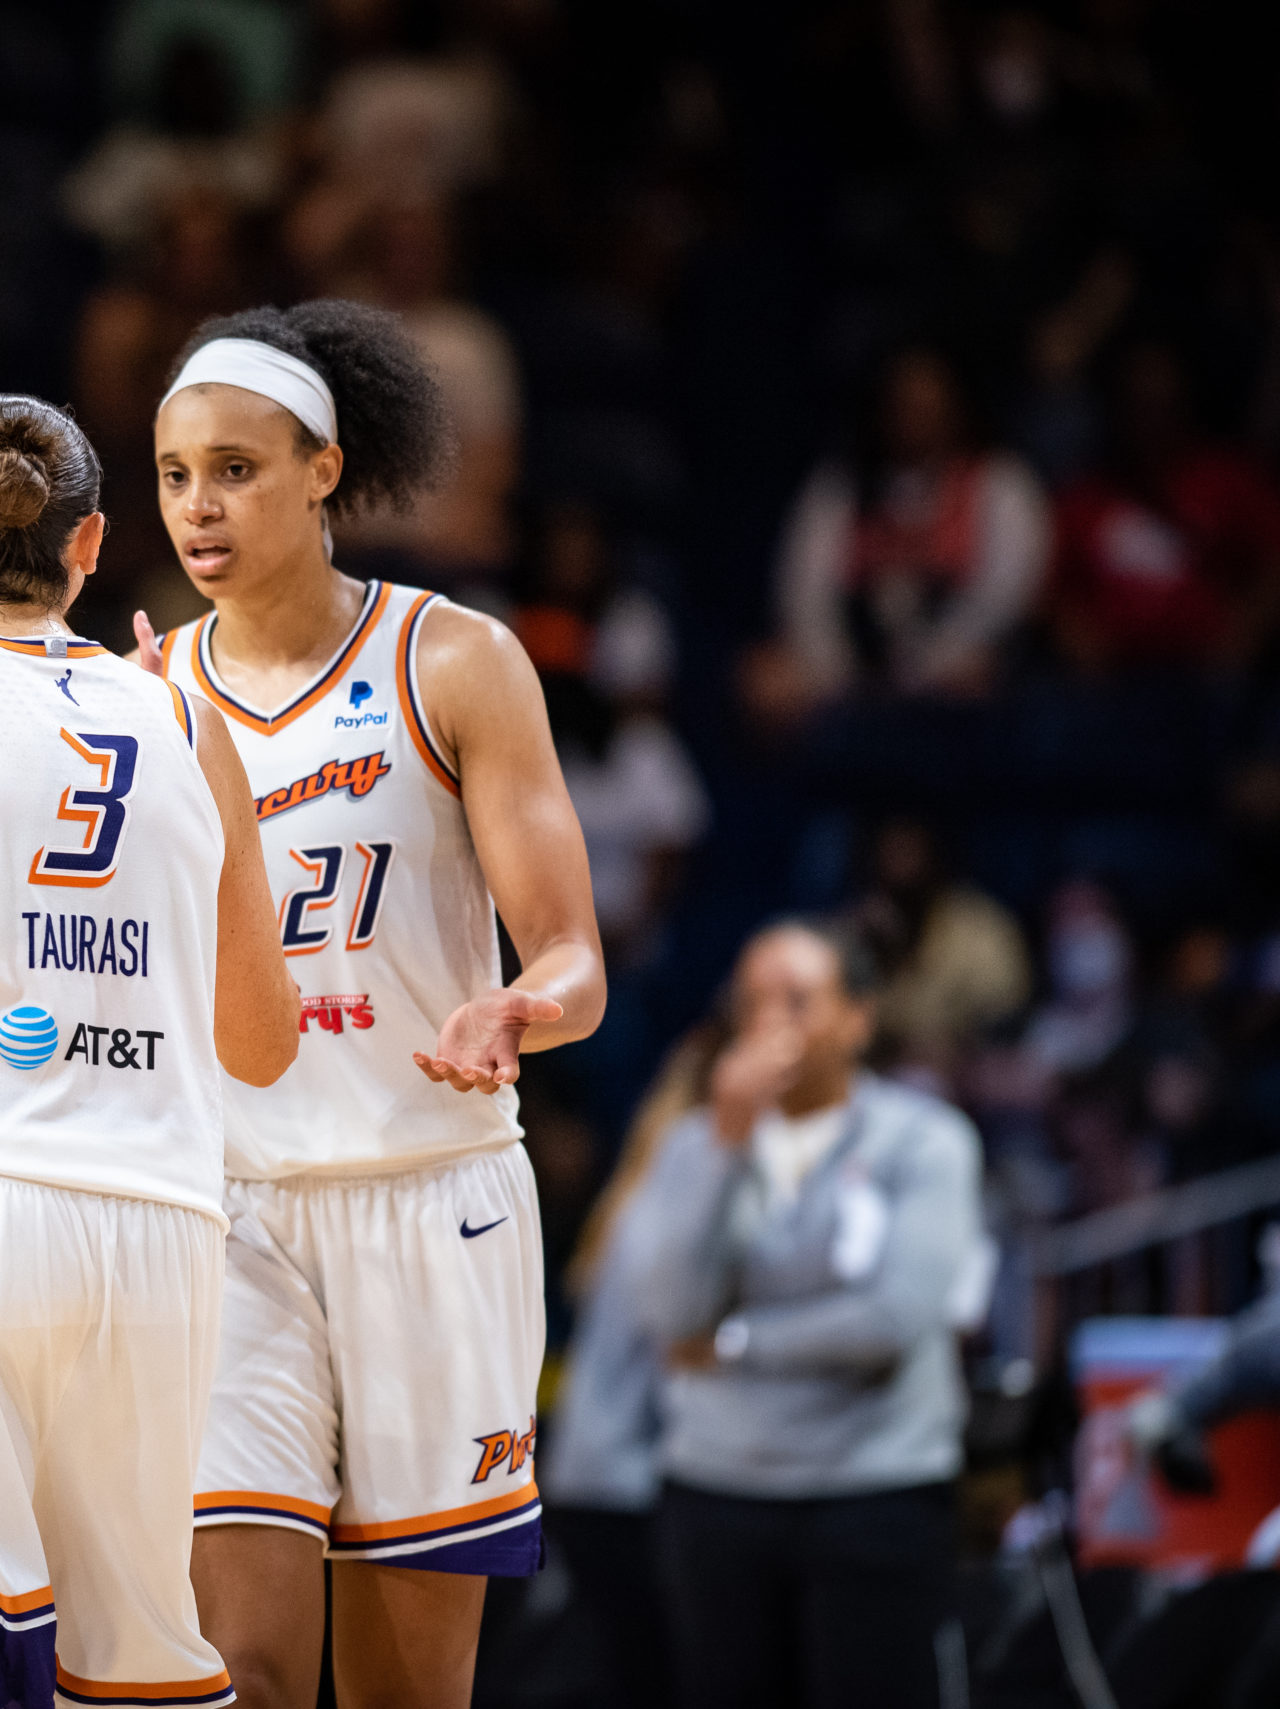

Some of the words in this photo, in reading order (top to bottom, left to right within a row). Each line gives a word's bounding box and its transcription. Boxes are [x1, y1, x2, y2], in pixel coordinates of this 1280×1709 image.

[334, 711, 388, 729] PayPal
[28, 727, 140, 888] 3
[278, 842, 397, 956] 21
[22, 912, 148, 977] TAURASI
[64, 1022, 165, 1070] AT&T
